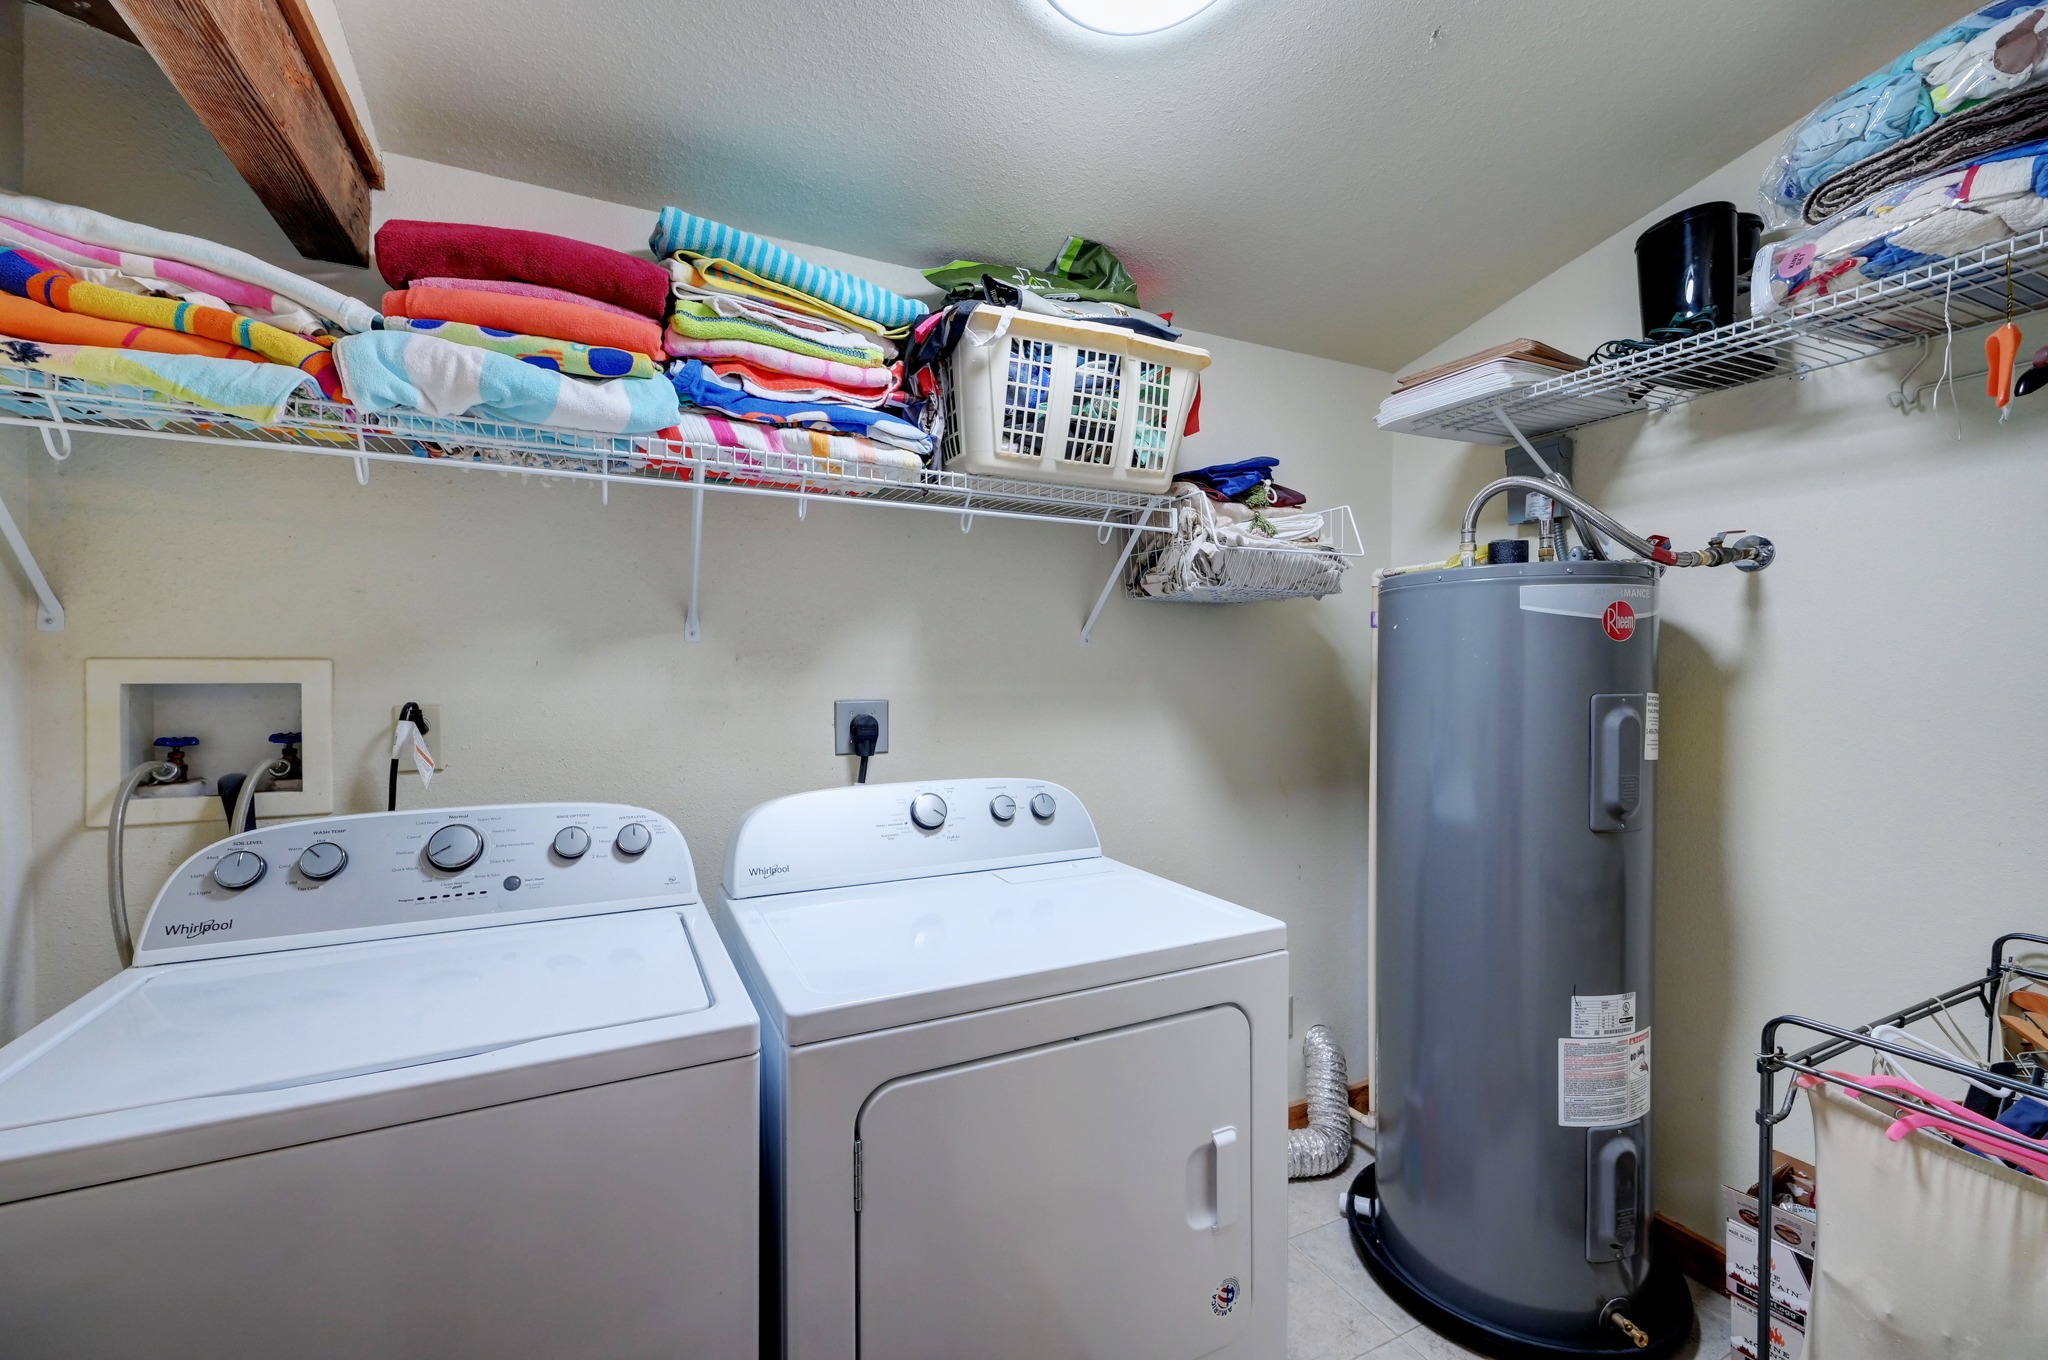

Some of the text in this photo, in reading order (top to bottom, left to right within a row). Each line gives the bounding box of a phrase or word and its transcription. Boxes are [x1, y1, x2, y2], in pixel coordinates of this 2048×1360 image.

[1788, 252, 1801, 269] KING
[1796, 253, 1806, 266] SET
[1607, 601, 1634, 635] Rheem
[748, 864, 789, 879] Whirlpool
[165, 919, 233, 939] Whirlpool
[1728, 1228, 1740, 1238] MADE
[1735, 1263, 1799, 1299] MOUTAIN
[1752, 1264, 1780, 1282] PE
[1210, 1293, 1233, 1317] AMERICA
[1736, 1302, 1748, 1310] MADE
